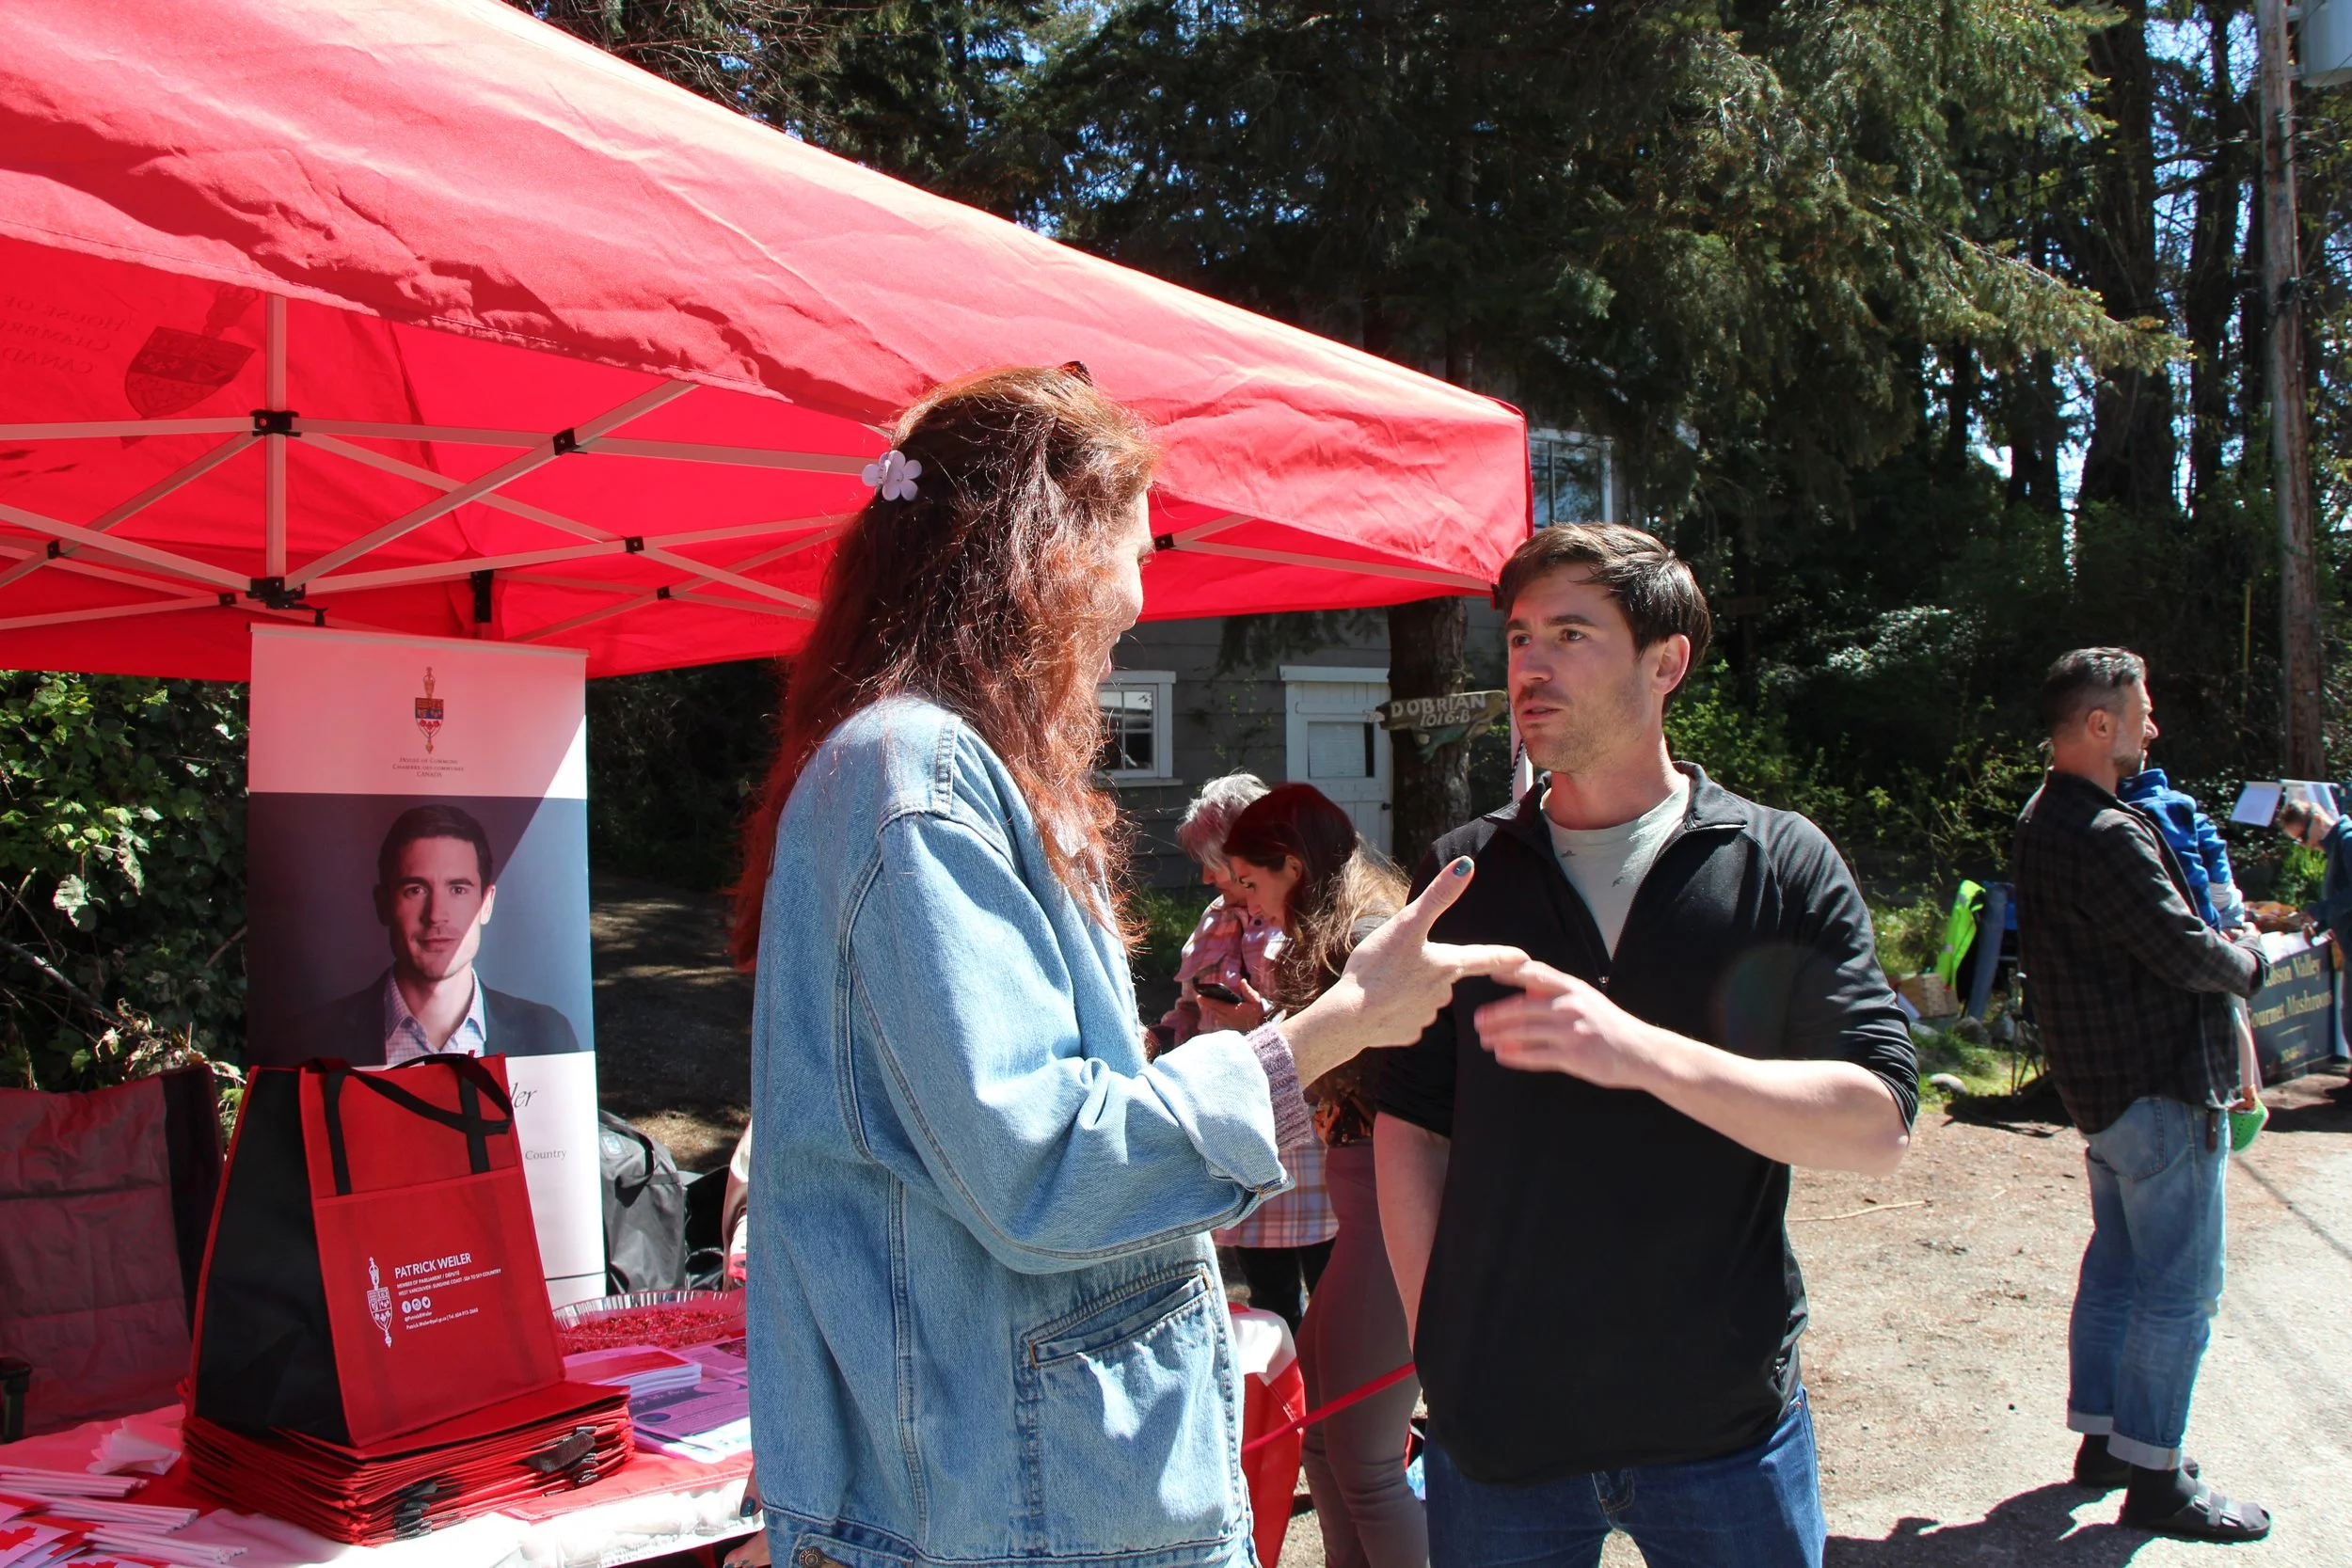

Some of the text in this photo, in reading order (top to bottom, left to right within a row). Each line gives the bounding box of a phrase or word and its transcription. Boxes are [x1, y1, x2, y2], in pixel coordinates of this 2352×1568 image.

[1391, 693, 1486, 718] DOBRIAN
[2291, 953, 2321, 981] Valley
[510, 1081, 538, 1108] ler
[525, 1149, 567, 1161] Country
[394, 1252, 472, 1279] PATRICK WEILER
[482, 1268, 501, 1277] COUNTRY
